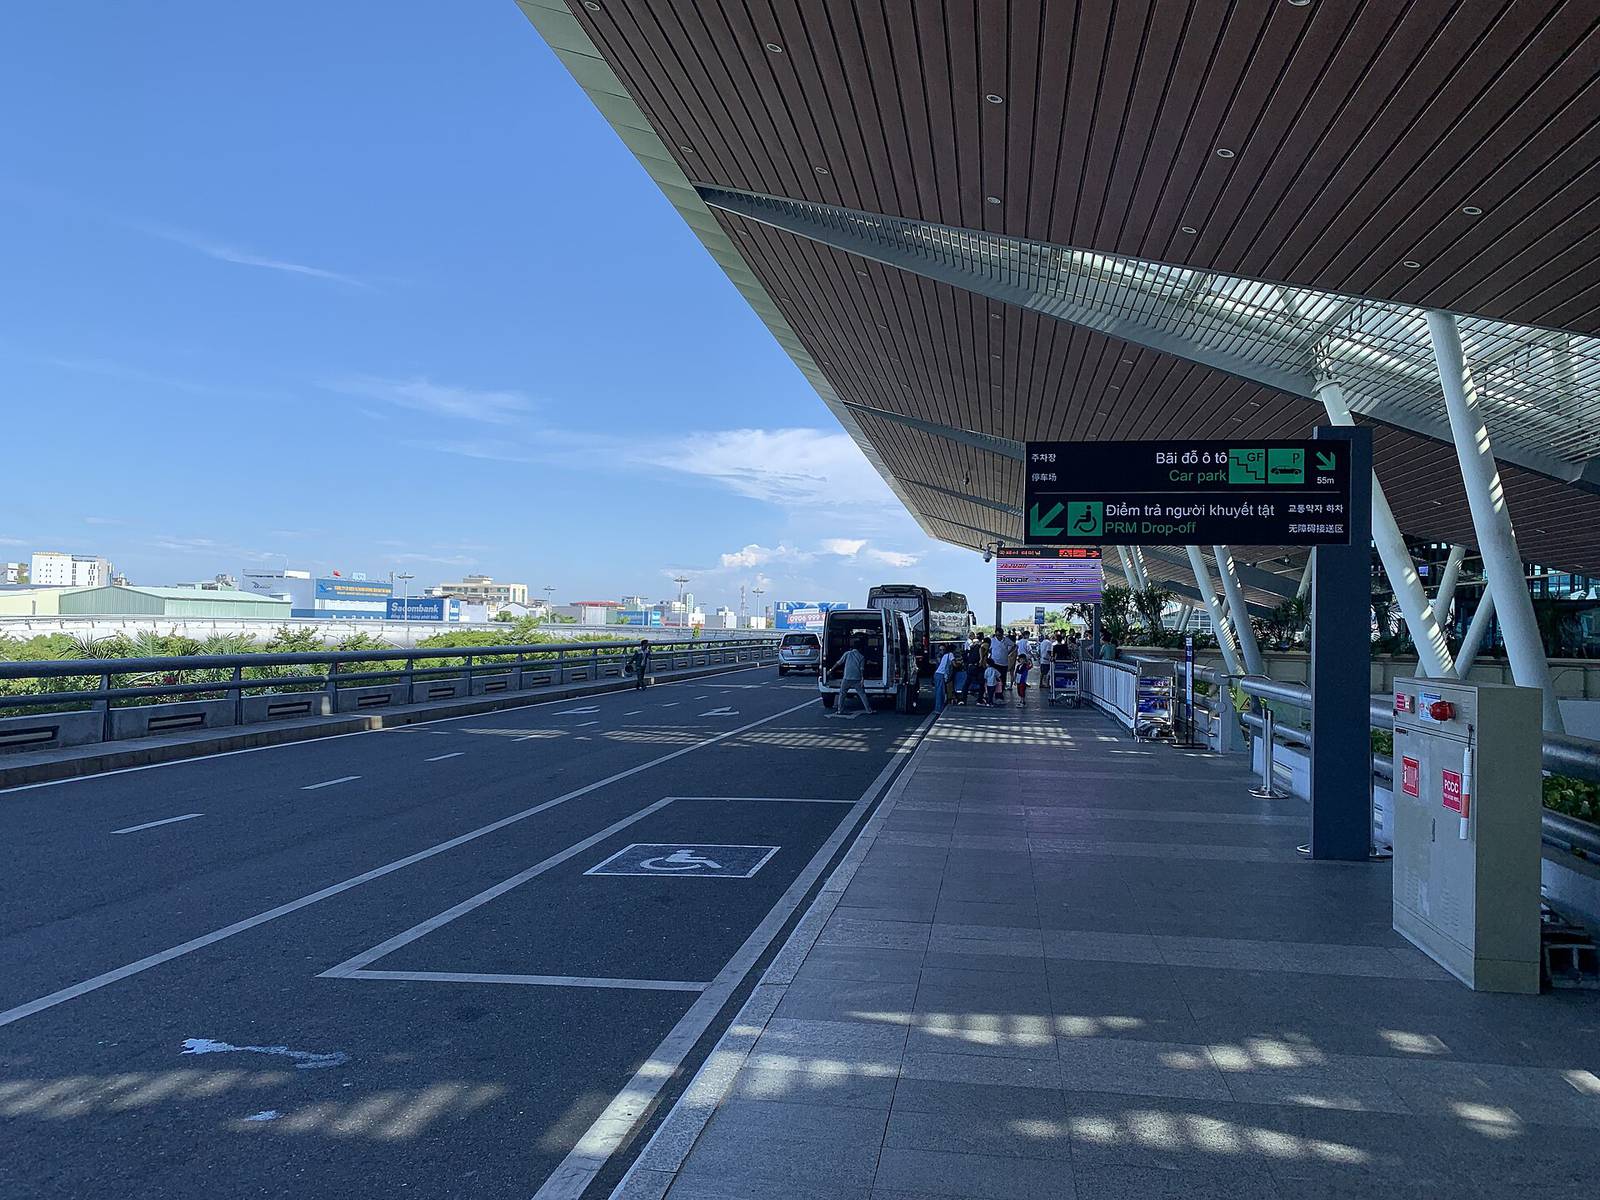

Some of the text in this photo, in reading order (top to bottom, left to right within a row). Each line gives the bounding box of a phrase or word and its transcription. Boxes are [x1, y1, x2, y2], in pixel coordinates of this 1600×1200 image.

[1031, 453, 1057, 463] 주차장
[1156, 449, 1228, 464] Bãi đỗ ô tô
[1246, 452, 1265, 463] GF
[1031, 472, 1057, 482] 停车场
[1169, 469, 1227, 485] Car park
[1316, 476, 1335, 485] 55m
[1105, 501, 1275, 519] Điểm trả người khuyết tật
[1105, 521, 1197, 537] PRM Drop-off
[390, 602, 440, 613] Sacombank
